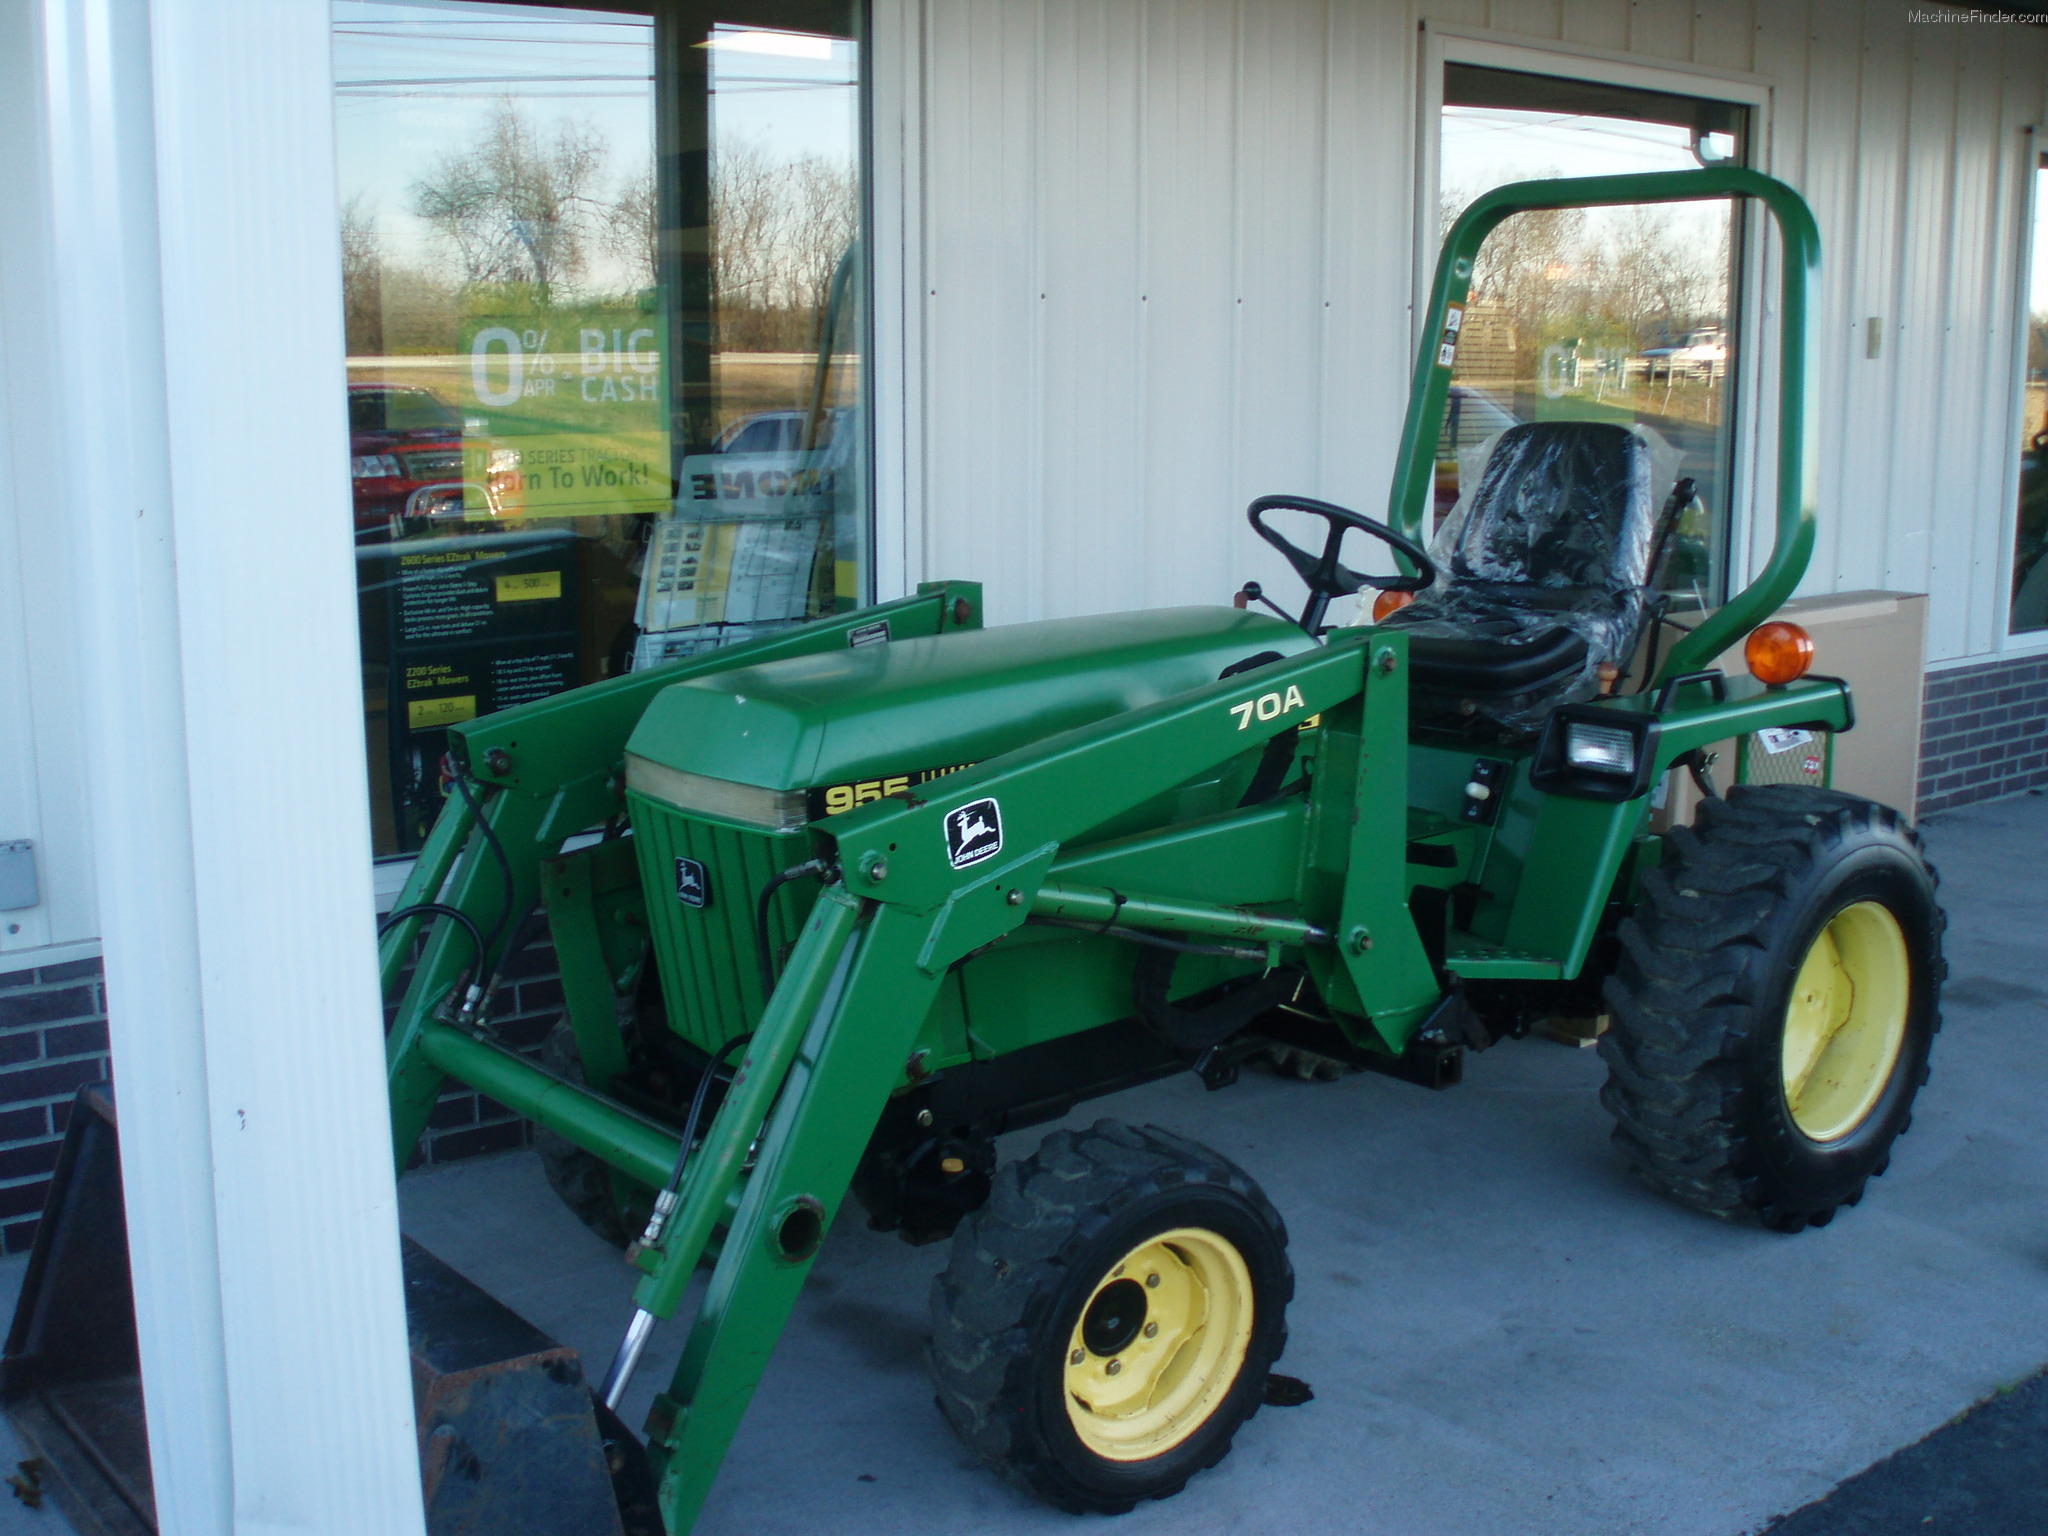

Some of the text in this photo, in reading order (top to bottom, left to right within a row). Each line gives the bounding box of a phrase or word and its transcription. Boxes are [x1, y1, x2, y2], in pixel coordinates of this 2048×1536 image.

[580, 328, 660, 374] BIG
[523, 378, 555, 397] APR
[581, 376, 658, 403] CASH
[527, 449, 576, 466] SERIES
[548, 466, 575, 489] To
[580, 461, 650, 488] Work!
[437, 675, 470, 686] Mowers
[1229, 684, 1305, 731] 70A
[825, 776, 910, 816] 955
[953, 840, 999, 865] JOHN DEERE
